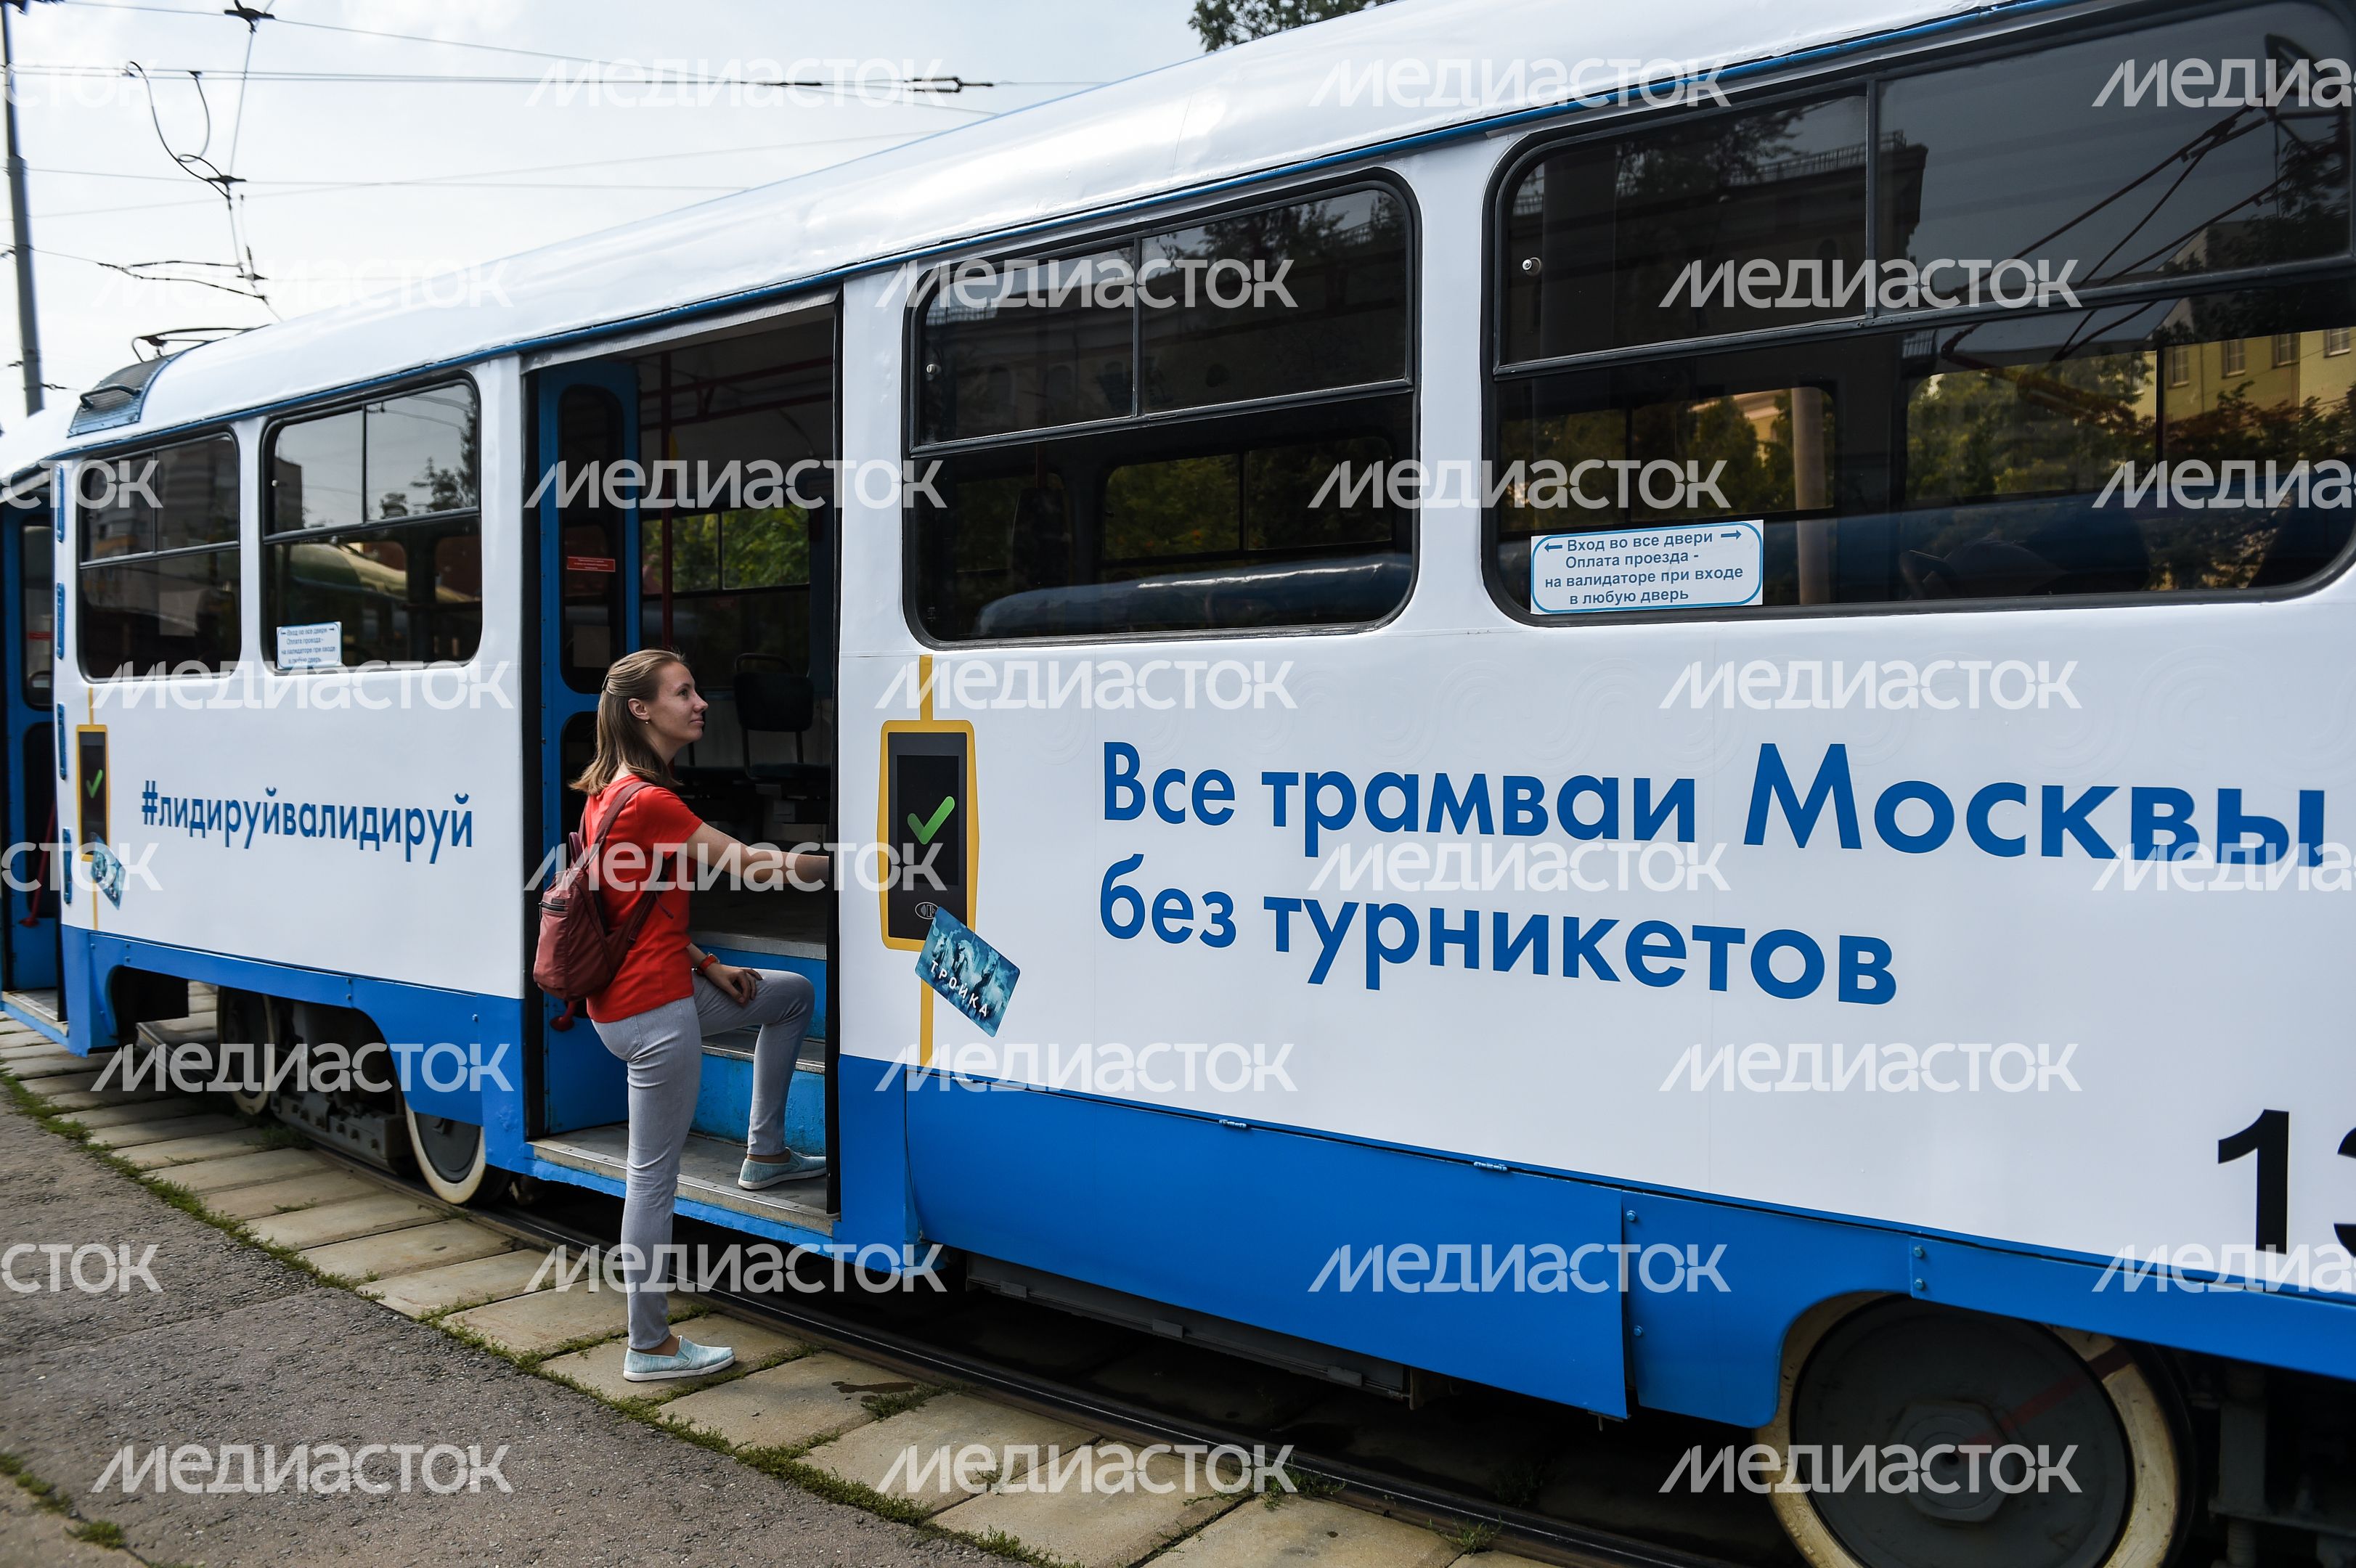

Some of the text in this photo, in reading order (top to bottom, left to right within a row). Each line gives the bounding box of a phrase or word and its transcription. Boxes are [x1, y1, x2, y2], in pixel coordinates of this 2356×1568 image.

[1566, 556, 1620, 568] Оплата
[1626, 552, 1688, 567] проезда
[1568, 533, 1713, 552] Вход во все двери
[1545, 568, 1743, 588] на валидаторе при входе
[1570, 590, 1689, 605] в любую дверь
[142, 780, 473, 865] #лидируйвалидируй
[1104, 741, 2325, 867] Все трамваи Москвы
[1100, 853, 1897, 1005] без турникетов
[930, 960, 988, 1017] ТРОЙКА
